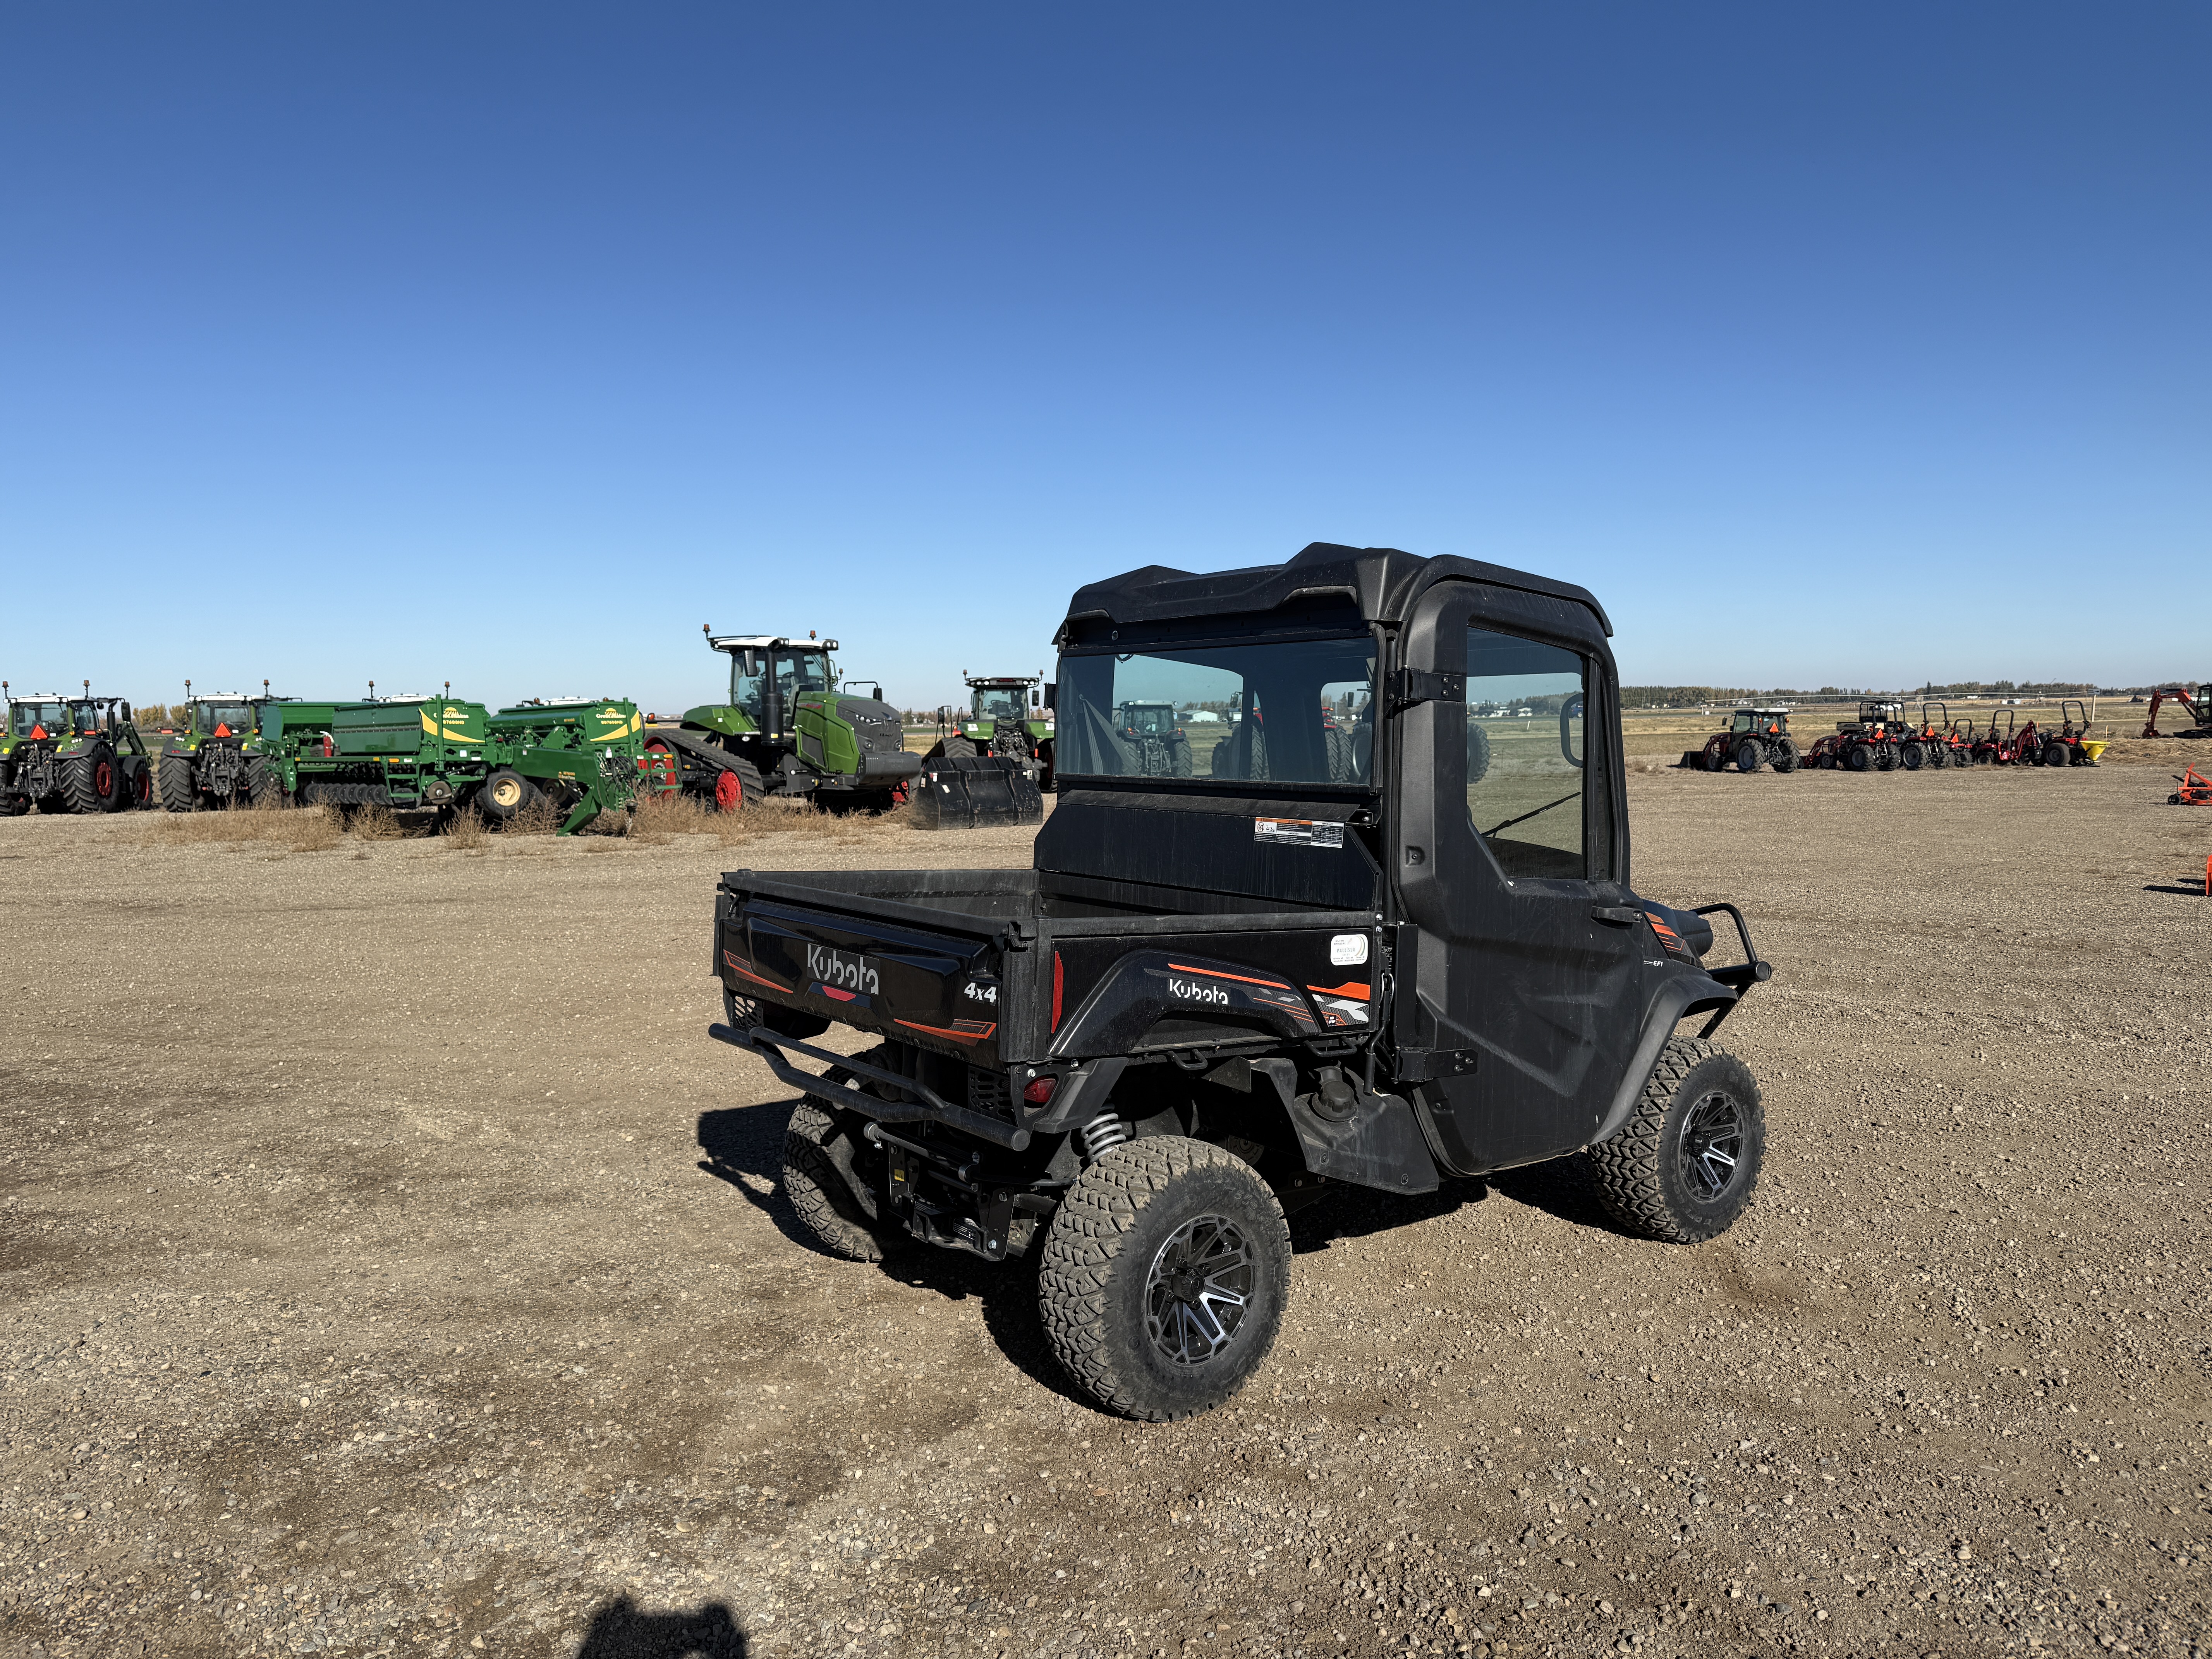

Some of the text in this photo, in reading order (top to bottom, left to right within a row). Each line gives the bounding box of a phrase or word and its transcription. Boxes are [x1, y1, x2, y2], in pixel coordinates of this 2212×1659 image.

[807, 944, 878, 994] Kubota
[964, 982, 996, 1003] 4x4
[1170, 979, 1228, 1005] Kubota
